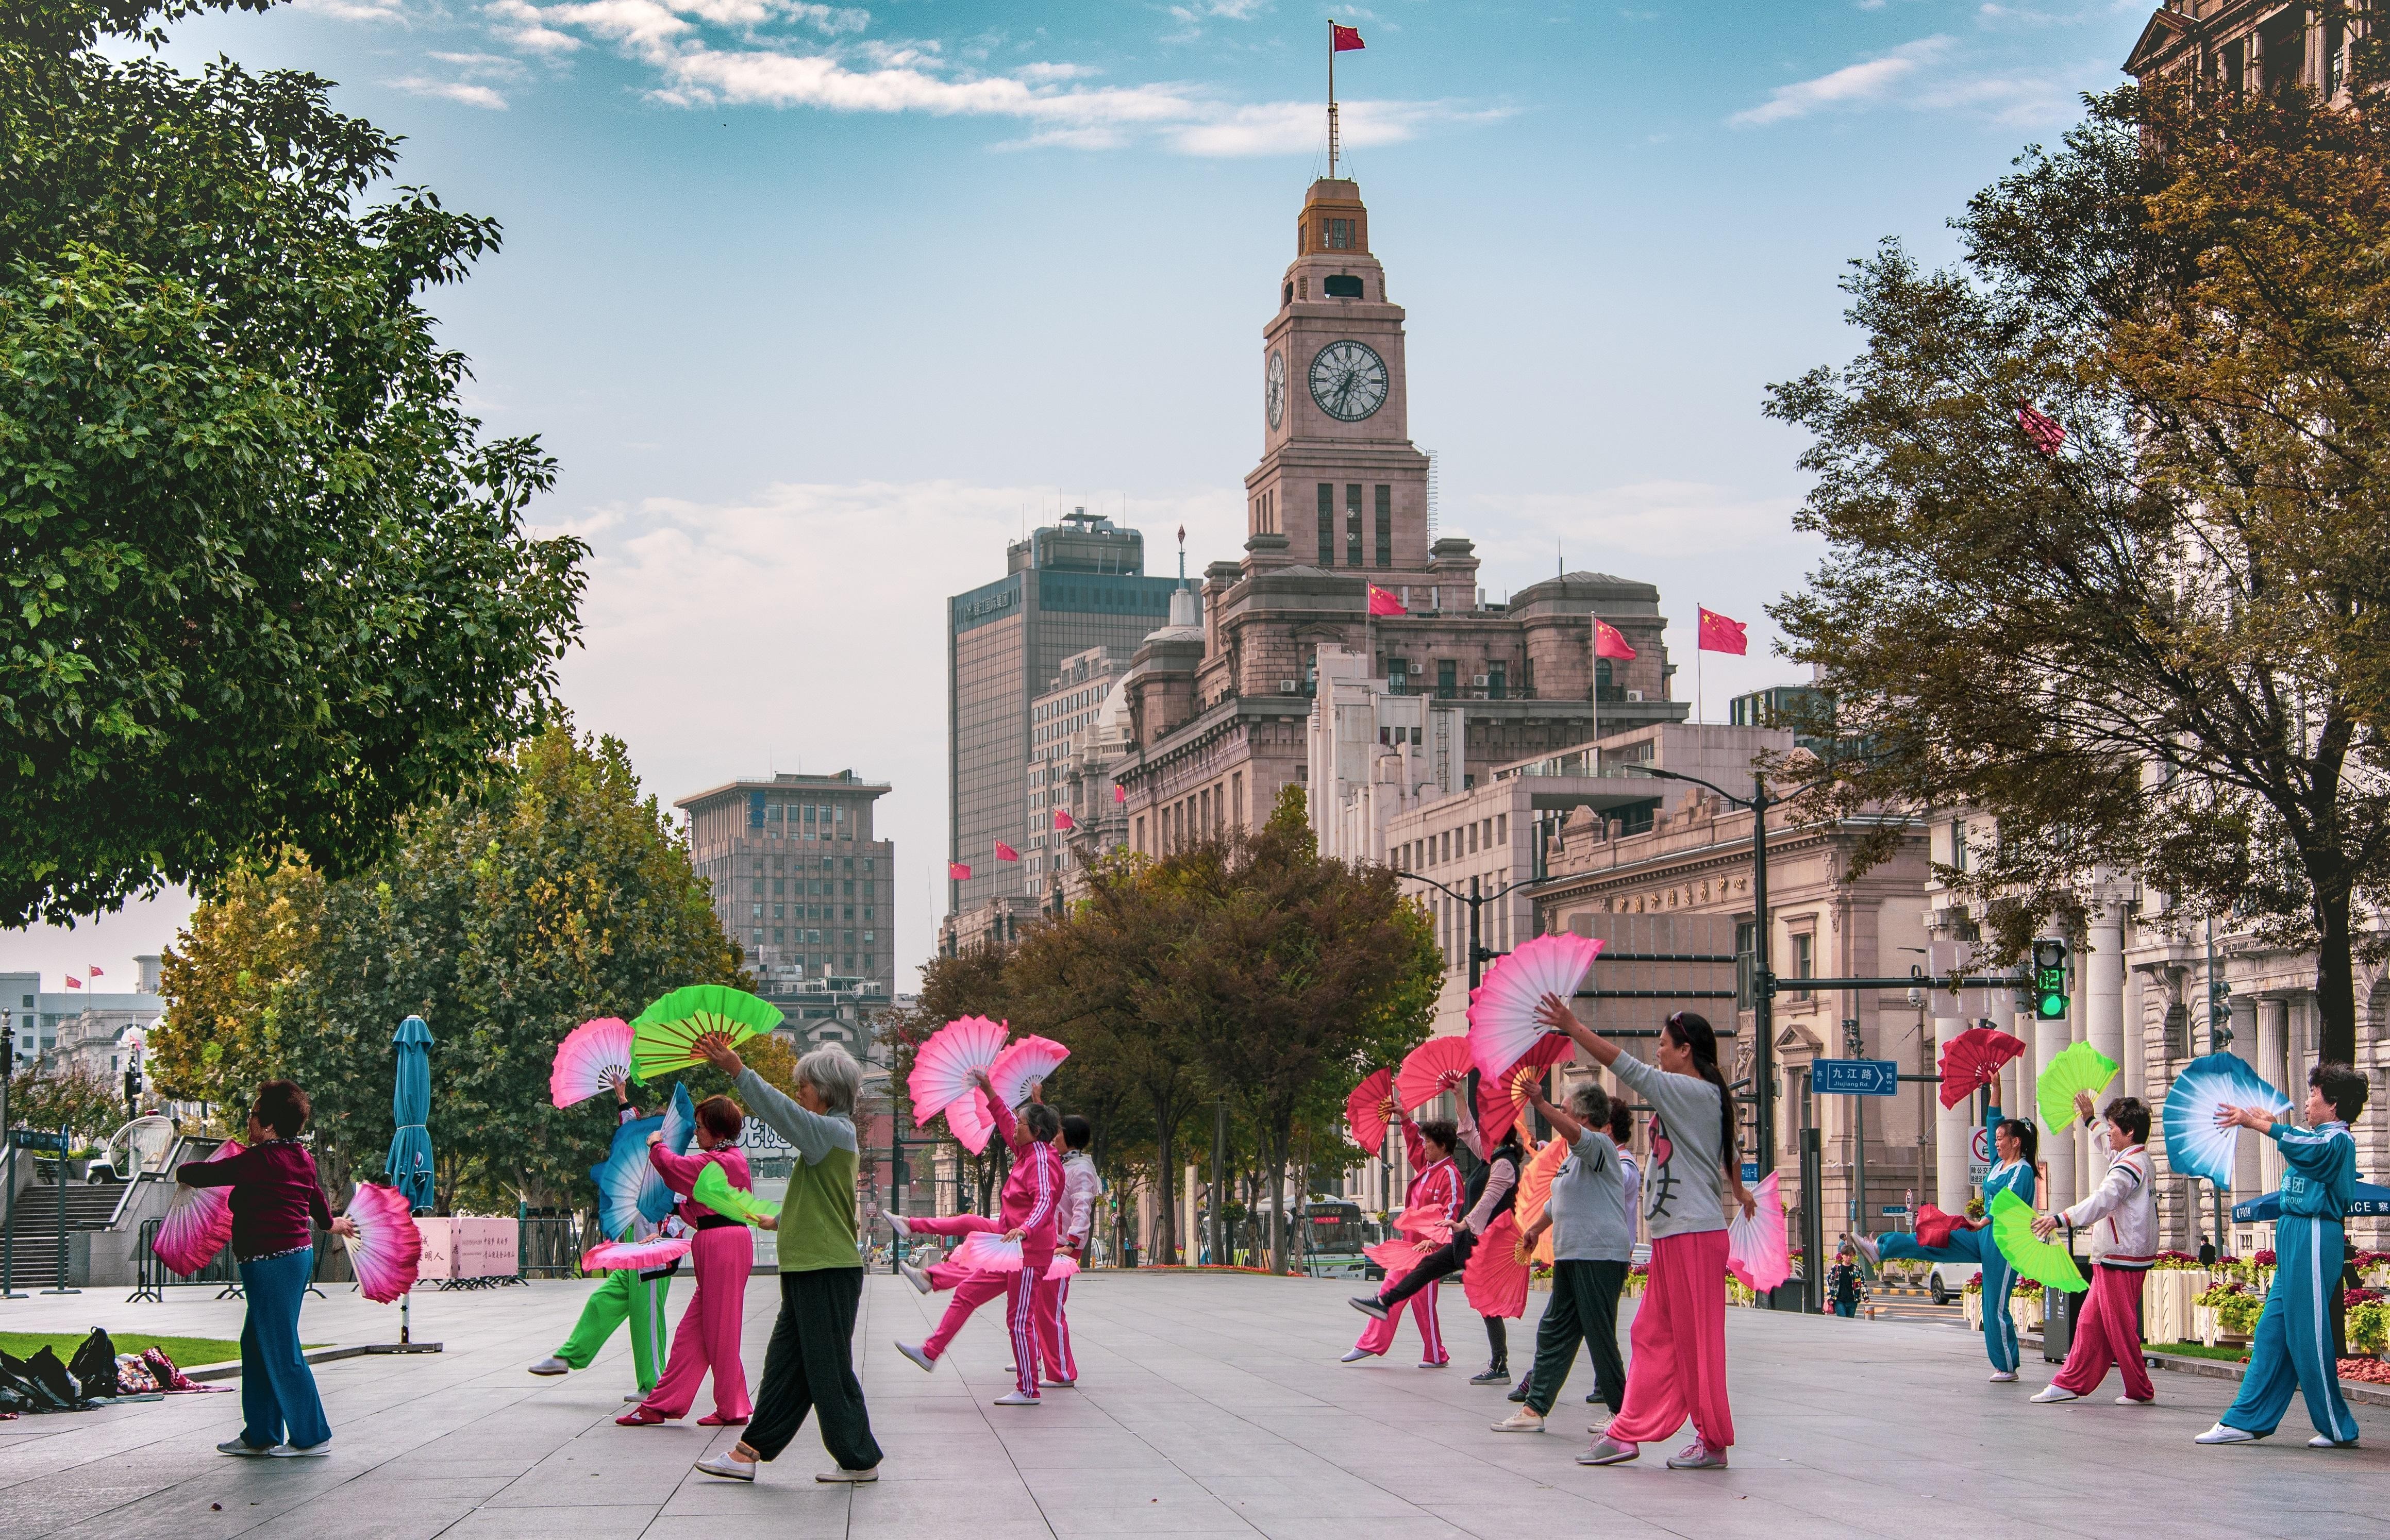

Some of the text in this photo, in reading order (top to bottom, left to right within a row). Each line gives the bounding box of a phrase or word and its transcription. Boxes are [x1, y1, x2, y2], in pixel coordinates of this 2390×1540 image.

[1833, 1068, 1871, 1080] 九江路
[2348, 1202, 2389, 1212] ICE 察
